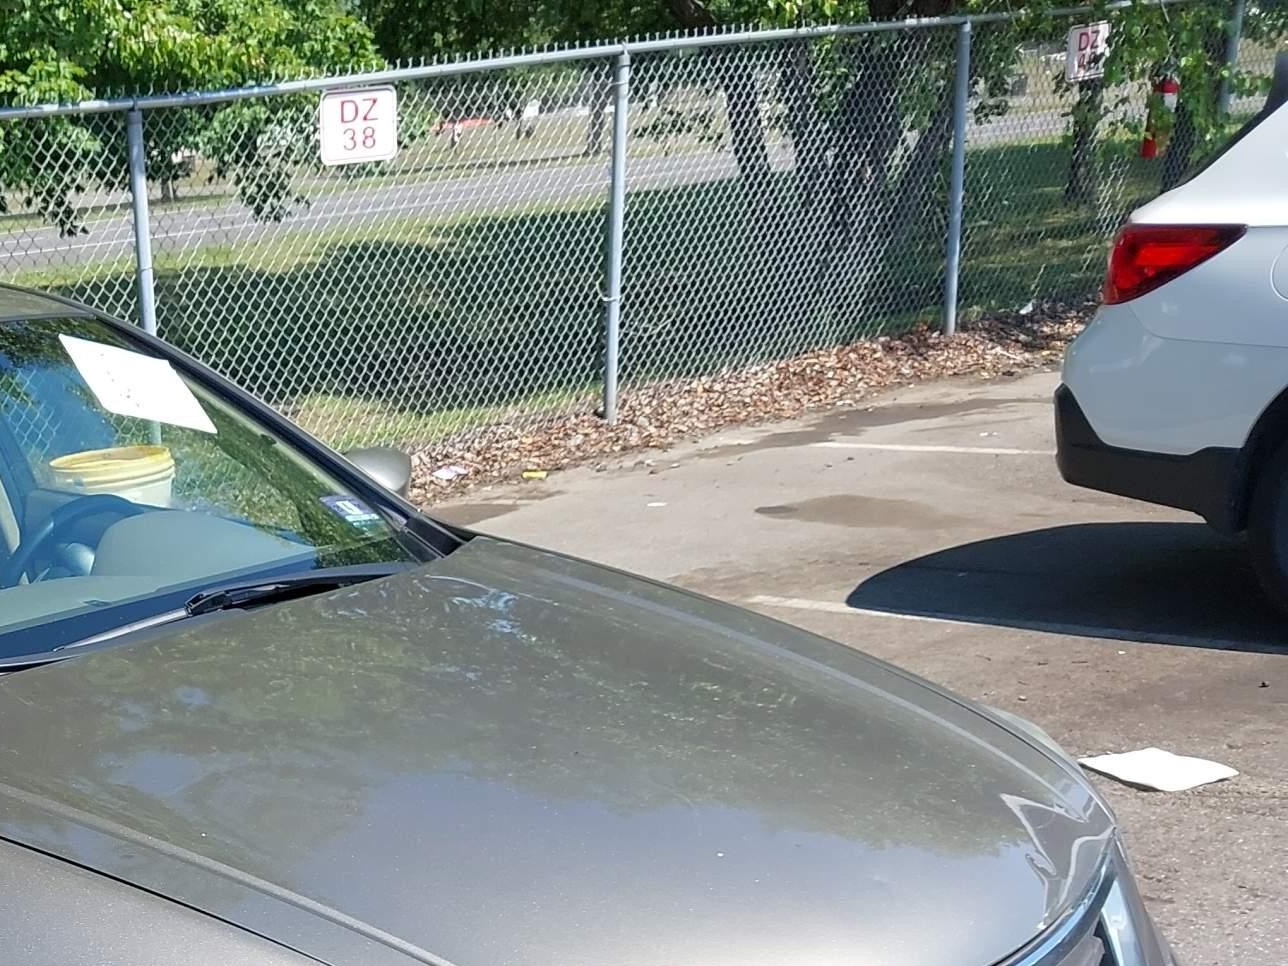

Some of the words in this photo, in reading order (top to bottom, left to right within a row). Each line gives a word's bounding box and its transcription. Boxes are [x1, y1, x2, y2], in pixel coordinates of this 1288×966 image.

[1078, 29, 1101, 51] DZ
[340, 97, 379, 124] DZ
[343, 126, 376, 151] 38
